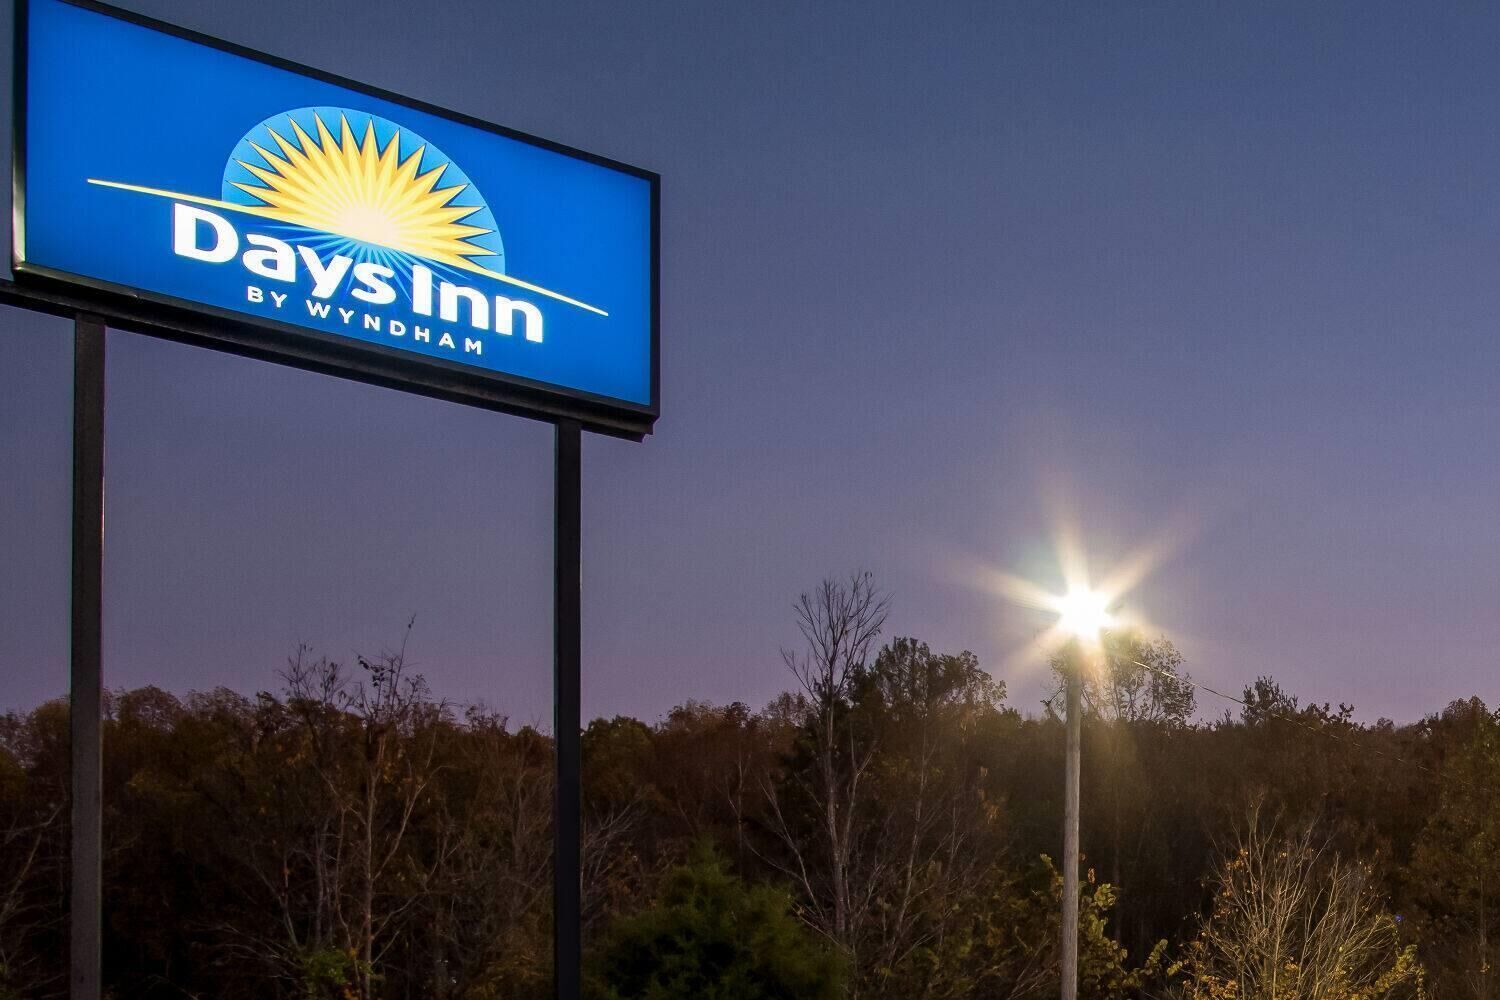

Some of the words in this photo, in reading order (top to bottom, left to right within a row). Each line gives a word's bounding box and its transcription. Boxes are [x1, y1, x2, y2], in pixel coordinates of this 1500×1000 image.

[173, 203, 397, 305] Days
[412, 264, 544, 343] Inn
[247, 285, 288, 308] BY
[306, 299, 483, 355] WYNDHAM
